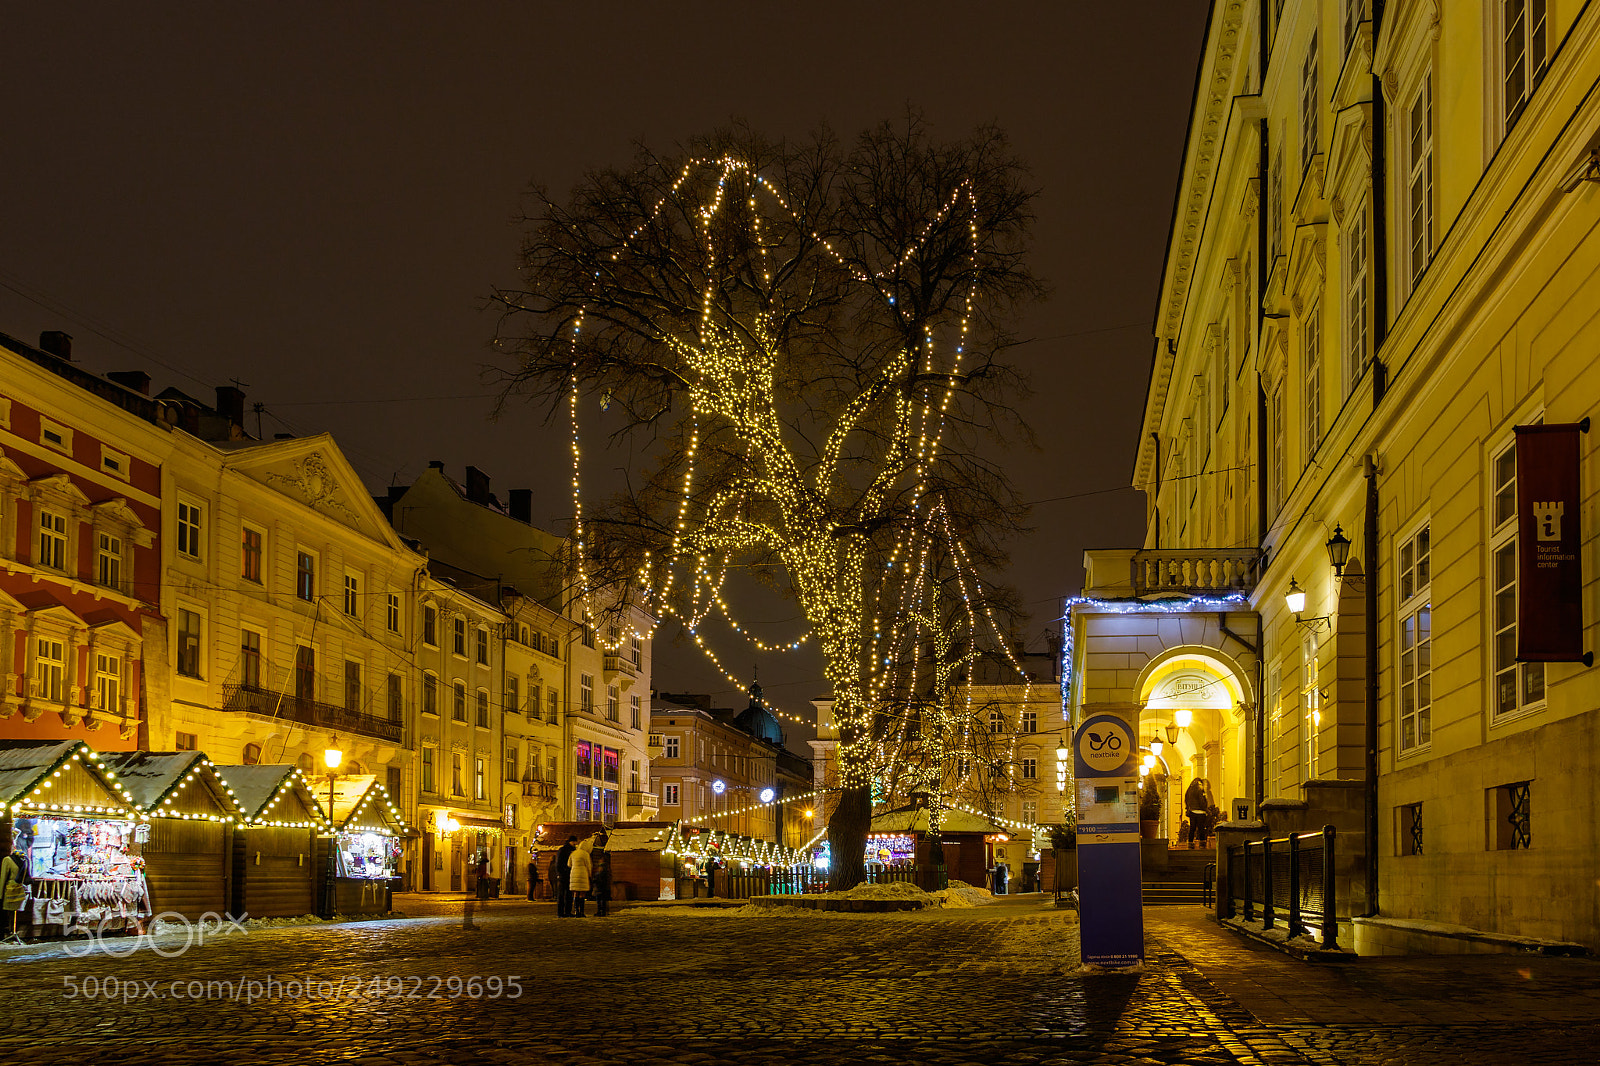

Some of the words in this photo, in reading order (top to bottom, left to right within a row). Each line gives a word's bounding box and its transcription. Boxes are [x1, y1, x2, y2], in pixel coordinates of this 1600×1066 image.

[1537, 545, 1560, 553] Tourist
[1537, 553, 1575, 561] information
[1090, 751, 1120, 759] nextbike
